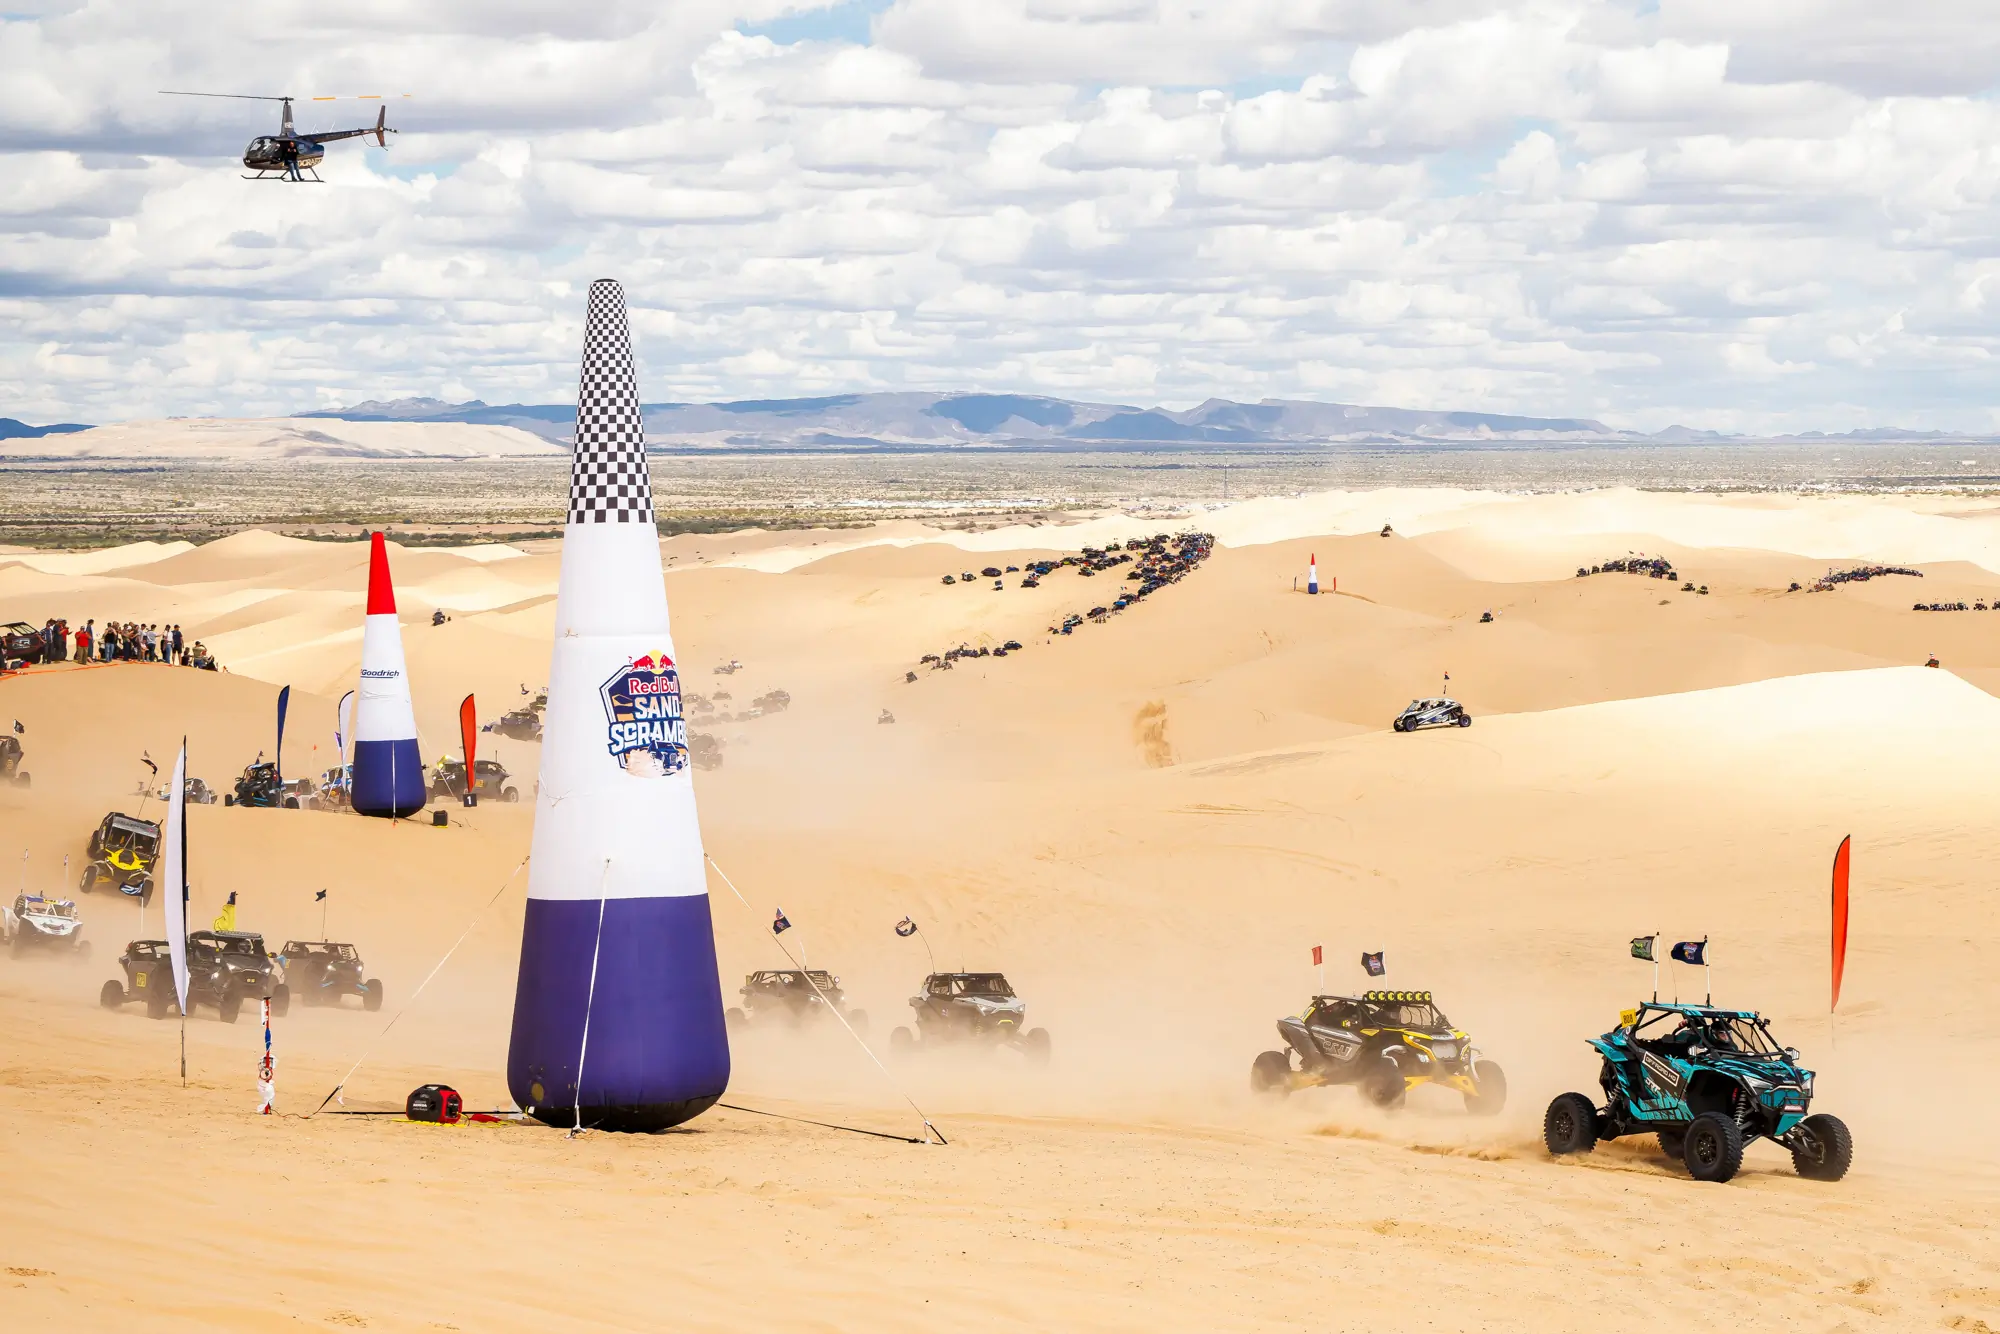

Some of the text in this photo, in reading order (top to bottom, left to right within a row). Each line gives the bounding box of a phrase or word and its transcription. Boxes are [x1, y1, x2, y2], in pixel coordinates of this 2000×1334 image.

[361, 669, 399, 677] Goodrich
[629, 677, 659, 694] Red
[634, 696, 681, 719] SAND
[610, 720, 687, 753] SCRAMB
[467, 796, 472, 805] 1
